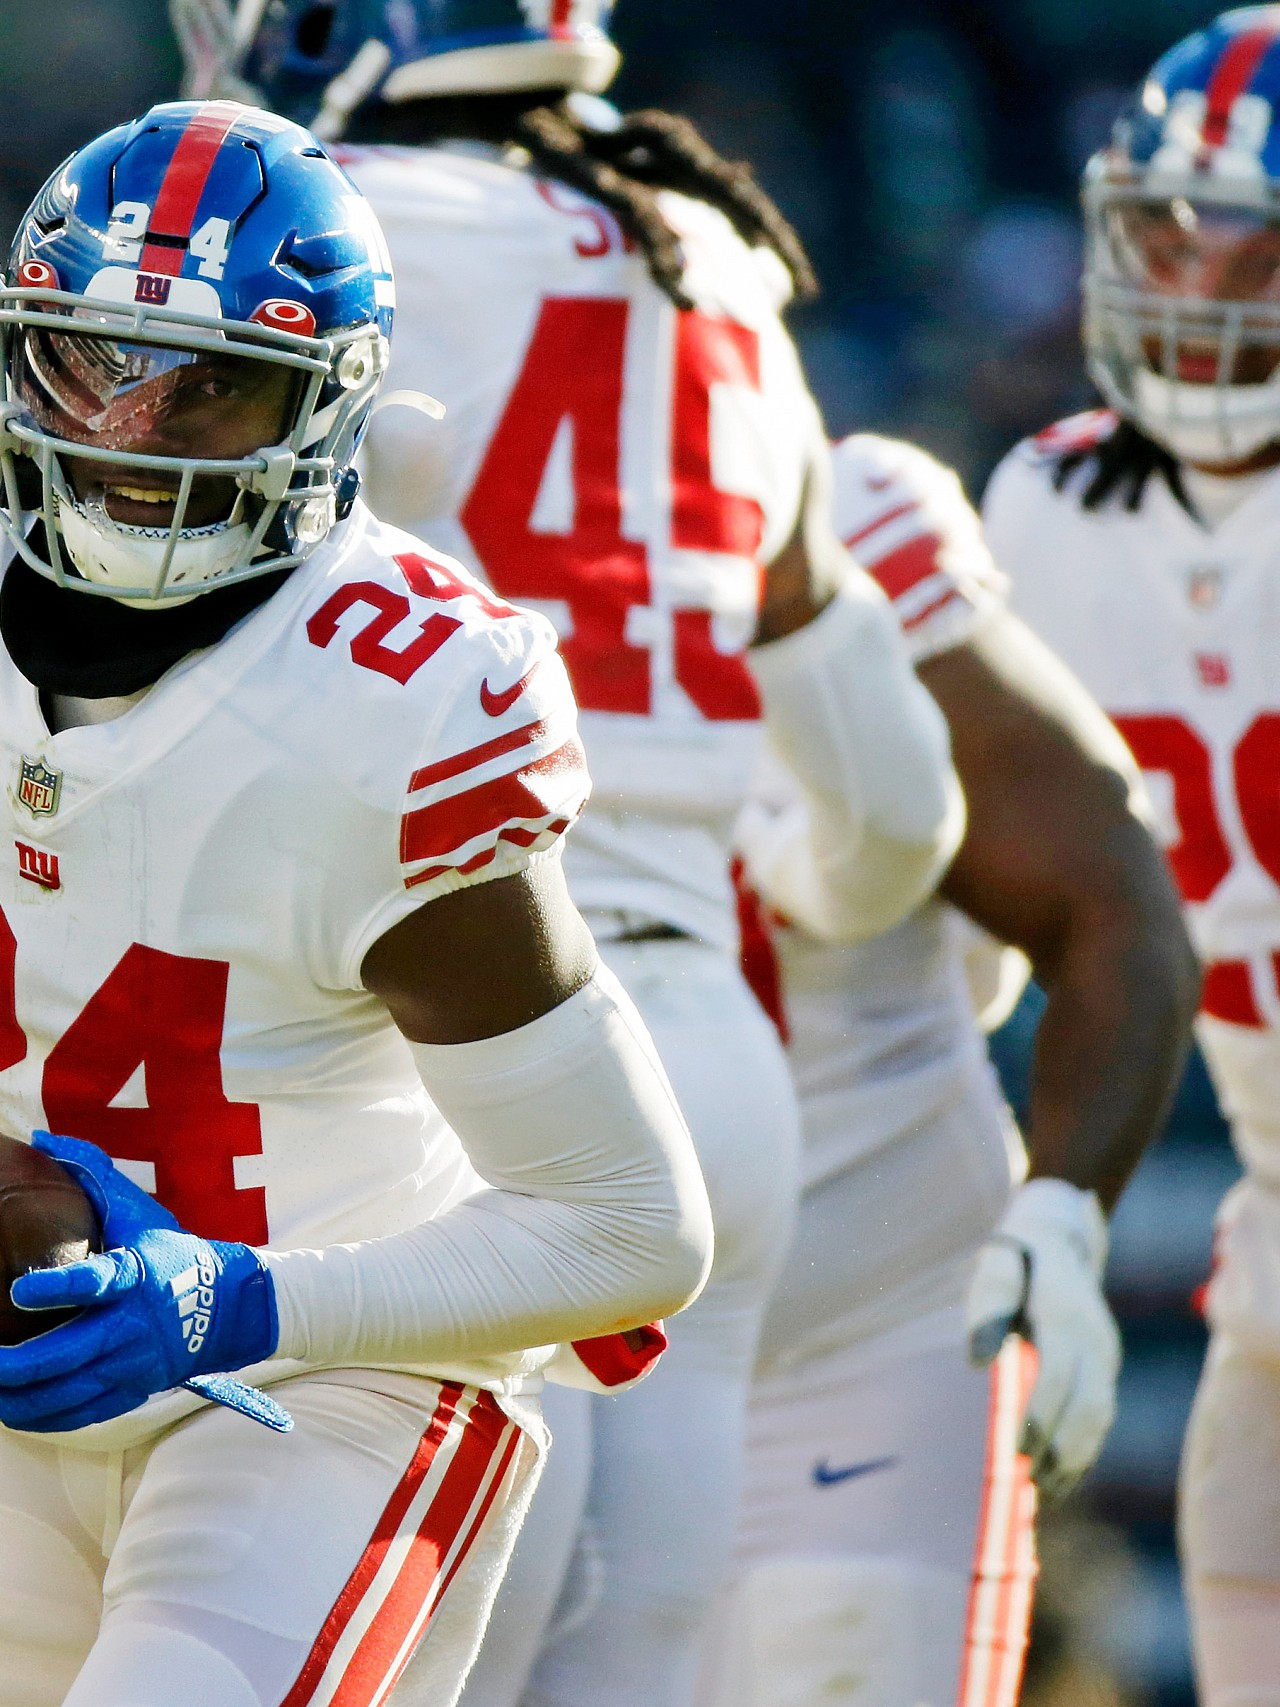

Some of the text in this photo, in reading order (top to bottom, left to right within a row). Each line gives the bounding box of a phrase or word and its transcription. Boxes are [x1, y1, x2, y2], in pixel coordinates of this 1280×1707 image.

[102, 201, 230, 280] 24
[306, 552, 523, 686] 24
[22, 779, 52, 809] NFL
[187, 1251, 216, 1353] adidas
